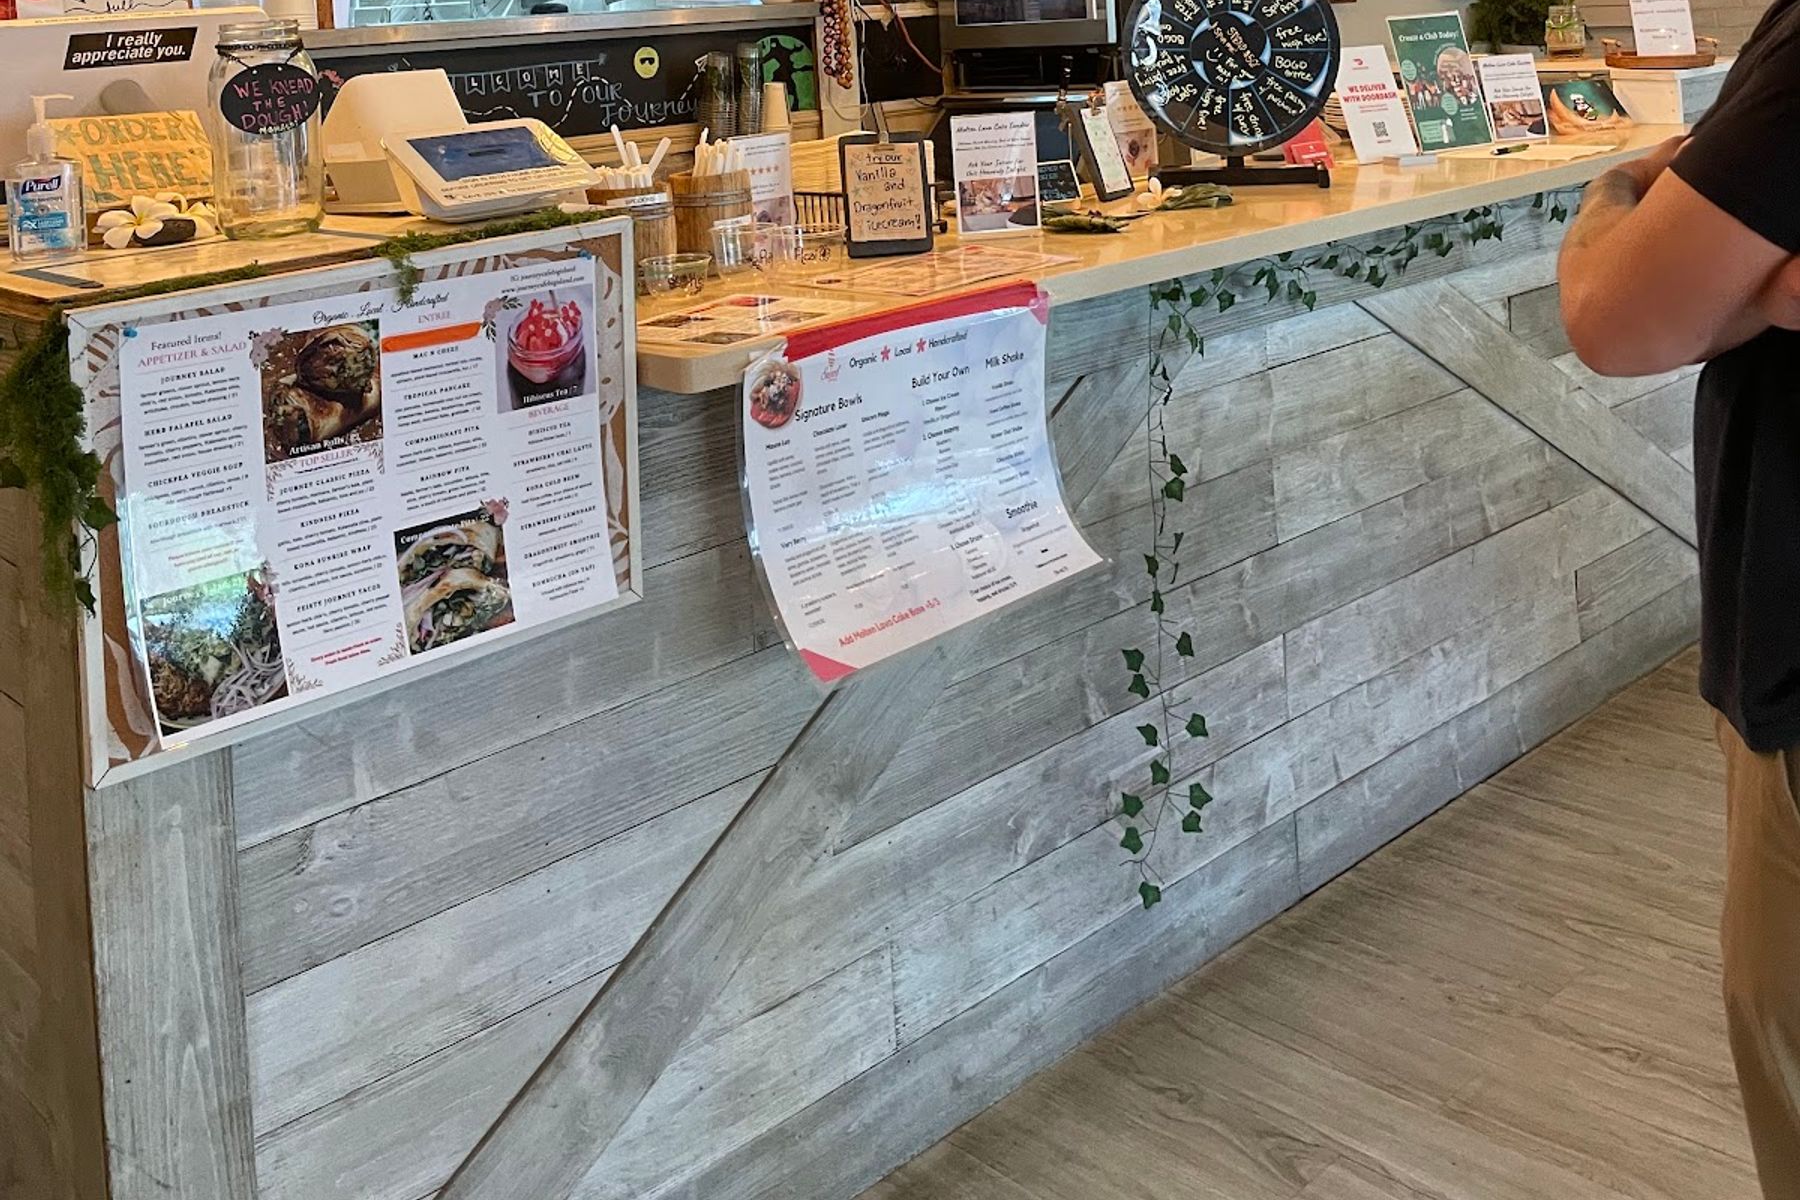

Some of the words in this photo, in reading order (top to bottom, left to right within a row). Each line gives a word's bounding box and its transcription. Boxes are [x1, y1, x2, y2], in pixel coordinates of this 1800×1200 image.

[106, 34, 112, 48] I
[117, 32, 163, 48] really
[72, 47, 154, 65] appreciate
[156, 44, 186, 60] you.
[1274, 55, 1308, 70] BOGO
[233, 81, 263, 99] WE
[269, 78, 314, 96] KNEAD
[527, 90, 562, 108] TO
[582, 82, 624, 104] OUR
[252, 96, 286, 112] THE
[79, 117, 186, 146] ORDER
[87, 151, 198, 190] HERE
[26, 179, 59, 192] Purell
[884, 178, 905, 192] and
[418, 310, 451, 324] ENTREE
[151, 336, 191, 351] Featured
[138, 350, 198, 368] APPETIZER
[211, 341, 247, 353] SALAD
[849, 354, 878, 369] Organic
[985, 354, 1000, 369] Milk
[1001, 351, 1024, 366] Shake
[161, 372, 197, 384] JOURNEY
[199, 366, 225, 377] SALAD
[911, 375, 931, 389] Build
[932, 369, 951, 383] Your
[952, 364, 971, 378] Own
[404, 389, 438, 400] TROPICAL
[440, 382, 471, 393] PANCAKE
[523, 392, 555, 404] Hibiscus
[556, 388, 569, 397] Tea
[528, 402, 569, 418] BEVERAGE
[795, 401, 836, 422] Signature
[838, 393, 863, 410] Bowls
[144, 427, 166, 436] HERB
[169, 420, 204, 432] FALAFEL
[206, 414, 233, 424] SALAD
[289, 442, 321, 455] Artisan
[300, 458, 320, 467] TOP
[320, 448, 354, 463] SELLER
[513, 452, 555, 467] STRAWBERRY
[148, 474, 188, 488] CHICKPEA
[191, 468, 221, 479] VEGGIE
[223, 462, 243, 472] SOUP
[280, 481, 313, 496] JOURNEY
[315, 473, 346, 485] CLASSIC
[348, 468, 370, 478] PIZZA
[420, 469, 452, 482] RAINBOW
[300, 513, 337, 528] KINDNESS
[339, 508, 360, 518] PIZZA
[1006, 500, 1038, 519] Smoothie
[351, 544, 372, 555] WRAP
